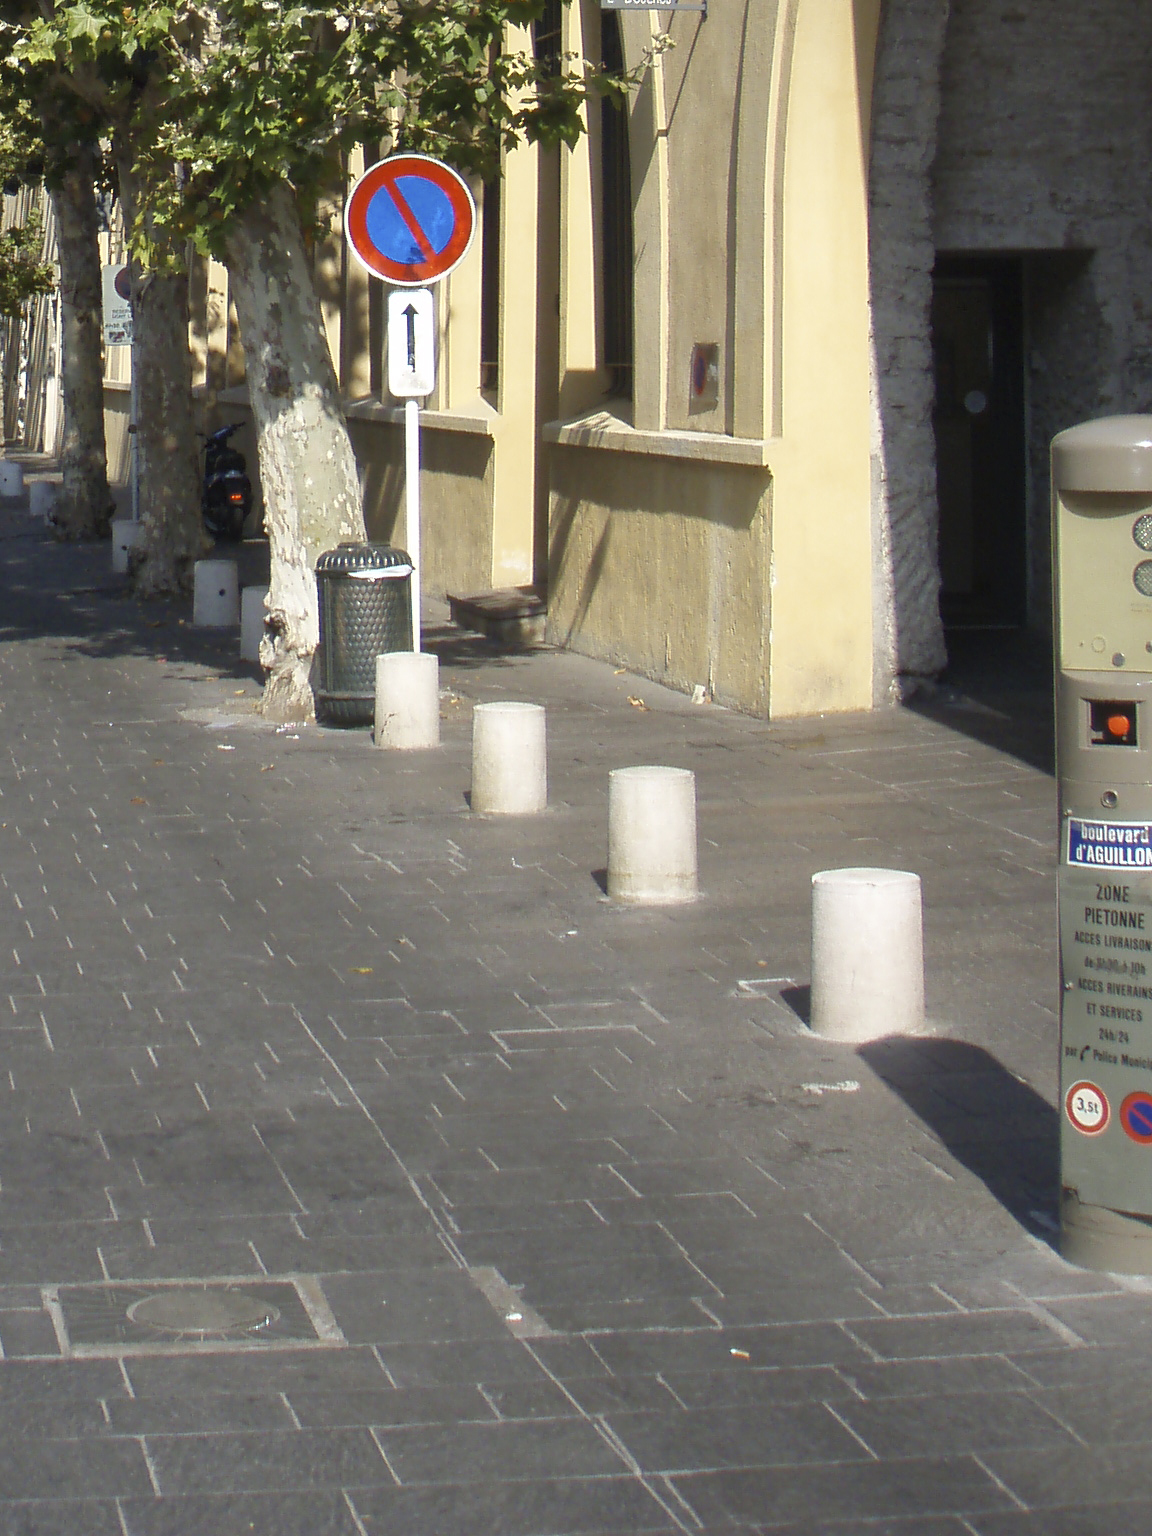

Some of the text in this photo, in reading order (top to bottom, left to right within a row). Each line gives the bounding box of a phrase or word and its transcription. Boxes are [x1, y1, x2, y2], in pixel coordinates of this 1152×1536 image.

[1081, 822, 1149, 843] boulevard
[1096, 884, 1130, 903] ZONE
[1084, 906, 1145, 930] PIETONNE
[1074, 931, 1101, 946] ACCES
[1078, 977, 1104, 993] ACCES
[1086, 1002, 1143, 1022] ET SERVICES
[1092, 1049, 1118, 1065] Police
